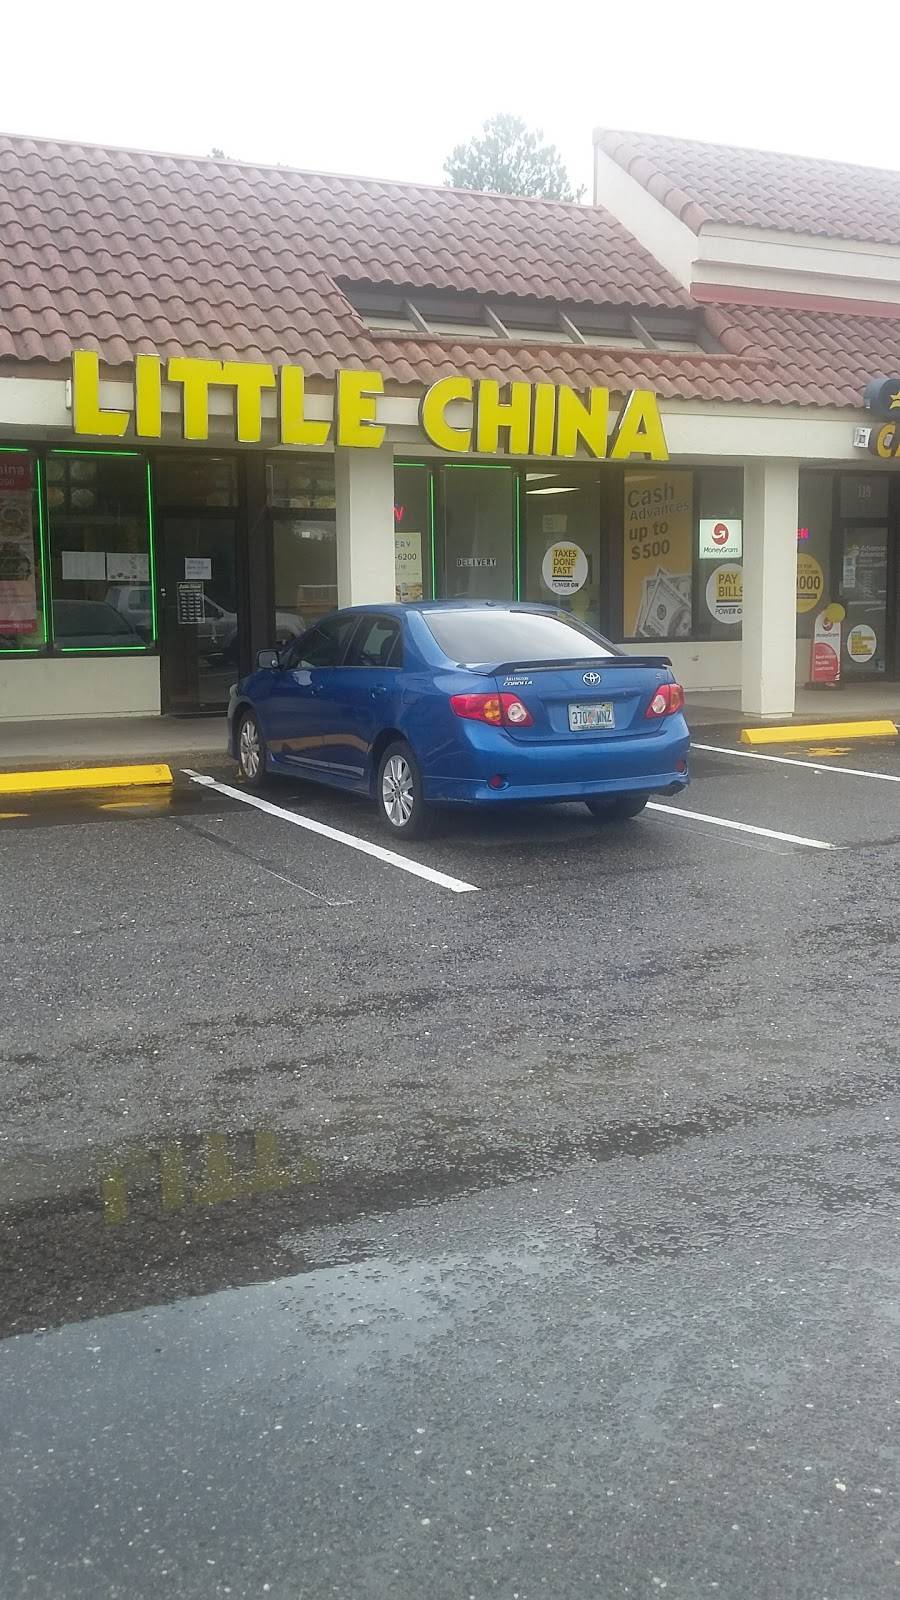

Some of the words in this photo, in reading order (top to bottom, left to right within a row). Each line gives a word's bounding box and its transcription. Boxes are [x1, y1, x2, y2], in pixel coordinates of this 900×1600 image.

[71, 349, 387, 448] LITTLE
[419, 375, 670, 461] CHINA
[627, 482, 675, 508] Cash
[629, 501, 689, 521] Advances
[629, 526, 648, 543] up
[653, 521, 669, 536] to
[554, 550, 577, 558] TAXES
[631, 539, 670, 561] $500
[703, 546, 739, 555] MoneyGram
[456, 558, 496, 567] DELIVERY
[718, 573, 738, 585] PAY
[715, 607, 736, 615] POWER
